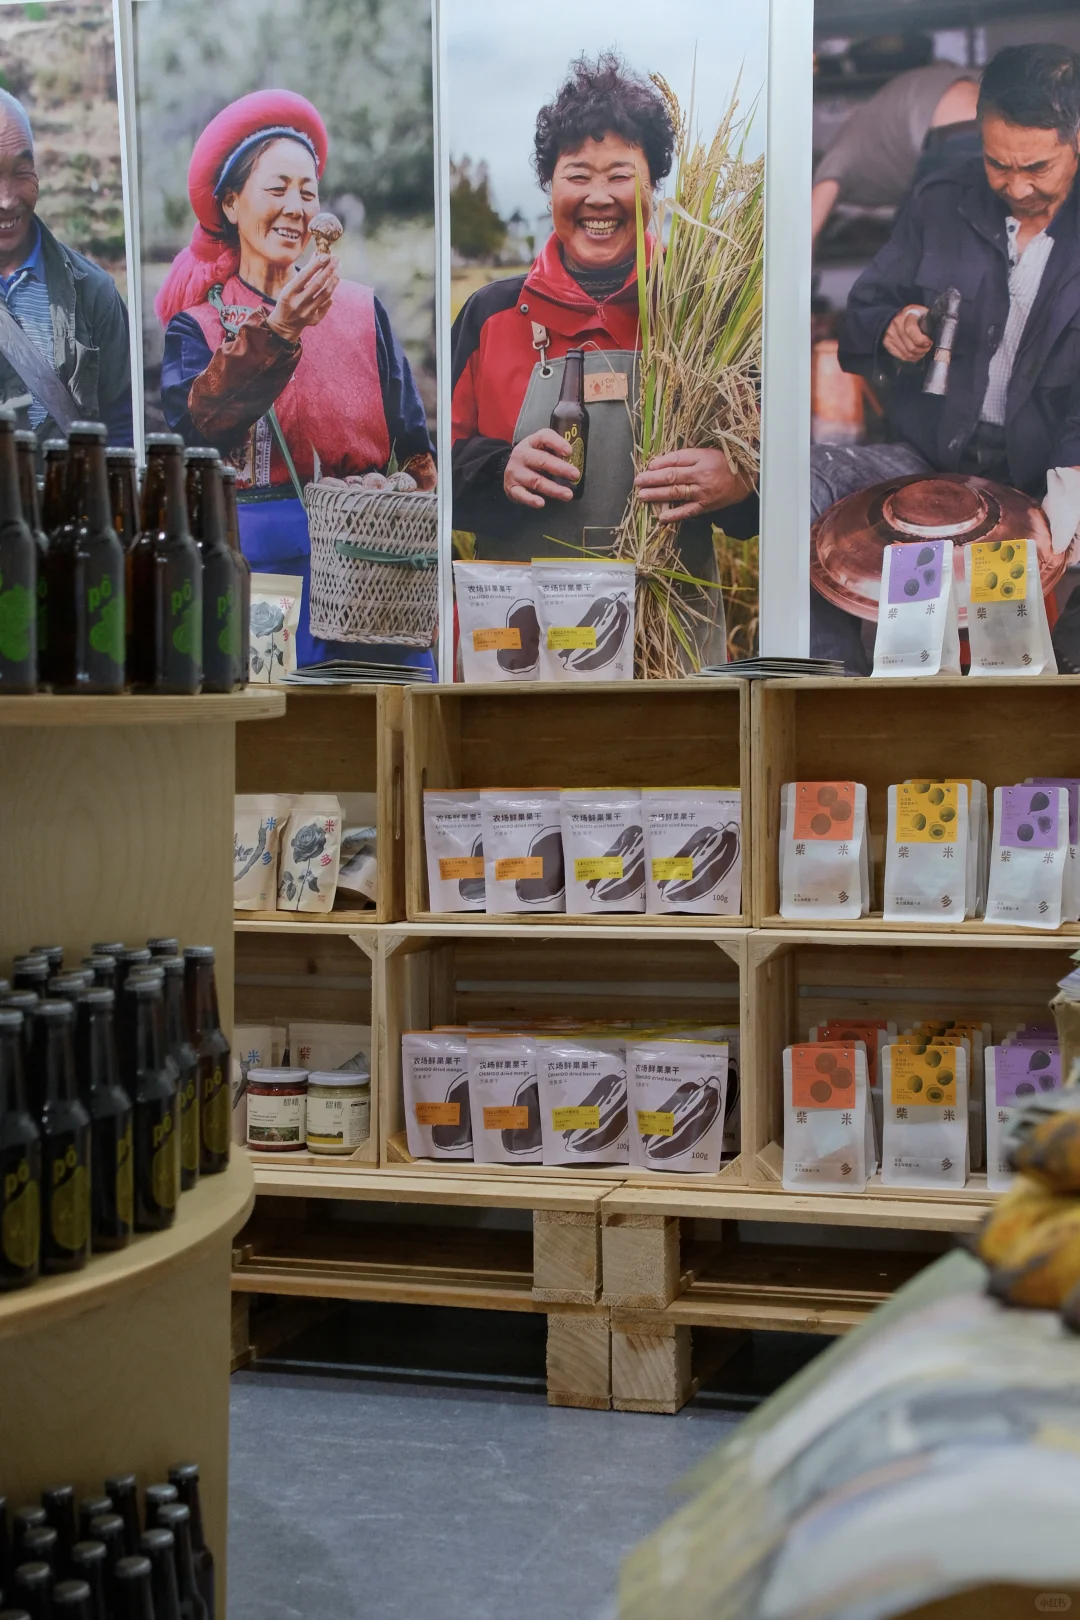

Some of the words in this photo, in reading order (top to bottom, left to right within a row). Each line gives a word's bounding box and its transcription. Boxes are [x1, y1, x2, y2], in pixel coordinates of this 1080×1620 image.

[468, 585, 512, 593] 农场鲜果果干
[543, 584, 591, 592] 农场鲜果果干
[280, 598, 292, 609] 米
[888, 608, 898, 619] 柴
[926, 603, 935, 615] 米
[977, 607, 987, 619] 柴
[1017, 605, 1027, 617] 米
[282, 629, 289, 642] 多
[920, 650, 929, 662] 多
[1022, 653, 1032, 665] 多
[266, 817, 276, 830] 米
[493, 813, 542, 822] 农场鲜果果干
[572, 813, 621, 822] 农场鲜果果干
[325, 819, 335, 832] 米
[796, 844, 805, 855] 柴
[838, 845, 848, 855] 米
[898, 846, 909, 858] 柴
[943, 846, 953, 858] 米
[262, 852, 272, 866] 多
[320, 853, 332, 867] 多
[1001, 850, 1011, 862] 柴
[1043, 852, 1054, 863] 米
[713, 894, 728, 903] 100g
[838, 891, 849, 903] 多
[941, 895, 952, 907] 多
[1039, 901, 1049, 913] 多
[248, 1050, 260, 1064] 米
[300, 1046, 311, 1060] 柴
[414, 1057, 461, 1065] 农场鲜果果干
[480, 1060, 528, 1069] 农场鲜果果干
[548, 1062, 598, 1070] 农场鲜果果干
[636, 1064, 680, 1075] 农场鲜果果干
[797, 1111, 807, 1124] 柴
[842, 1113, 852, 1125] 米
[896, 1107, 907, 1119] 柴
[944, 1110, 955, 1121] 米
[692, 1152, 708, 1160] 100g
[841, 1163, 852, 1175] 多
[941, 1158, 952, 1171] 多
